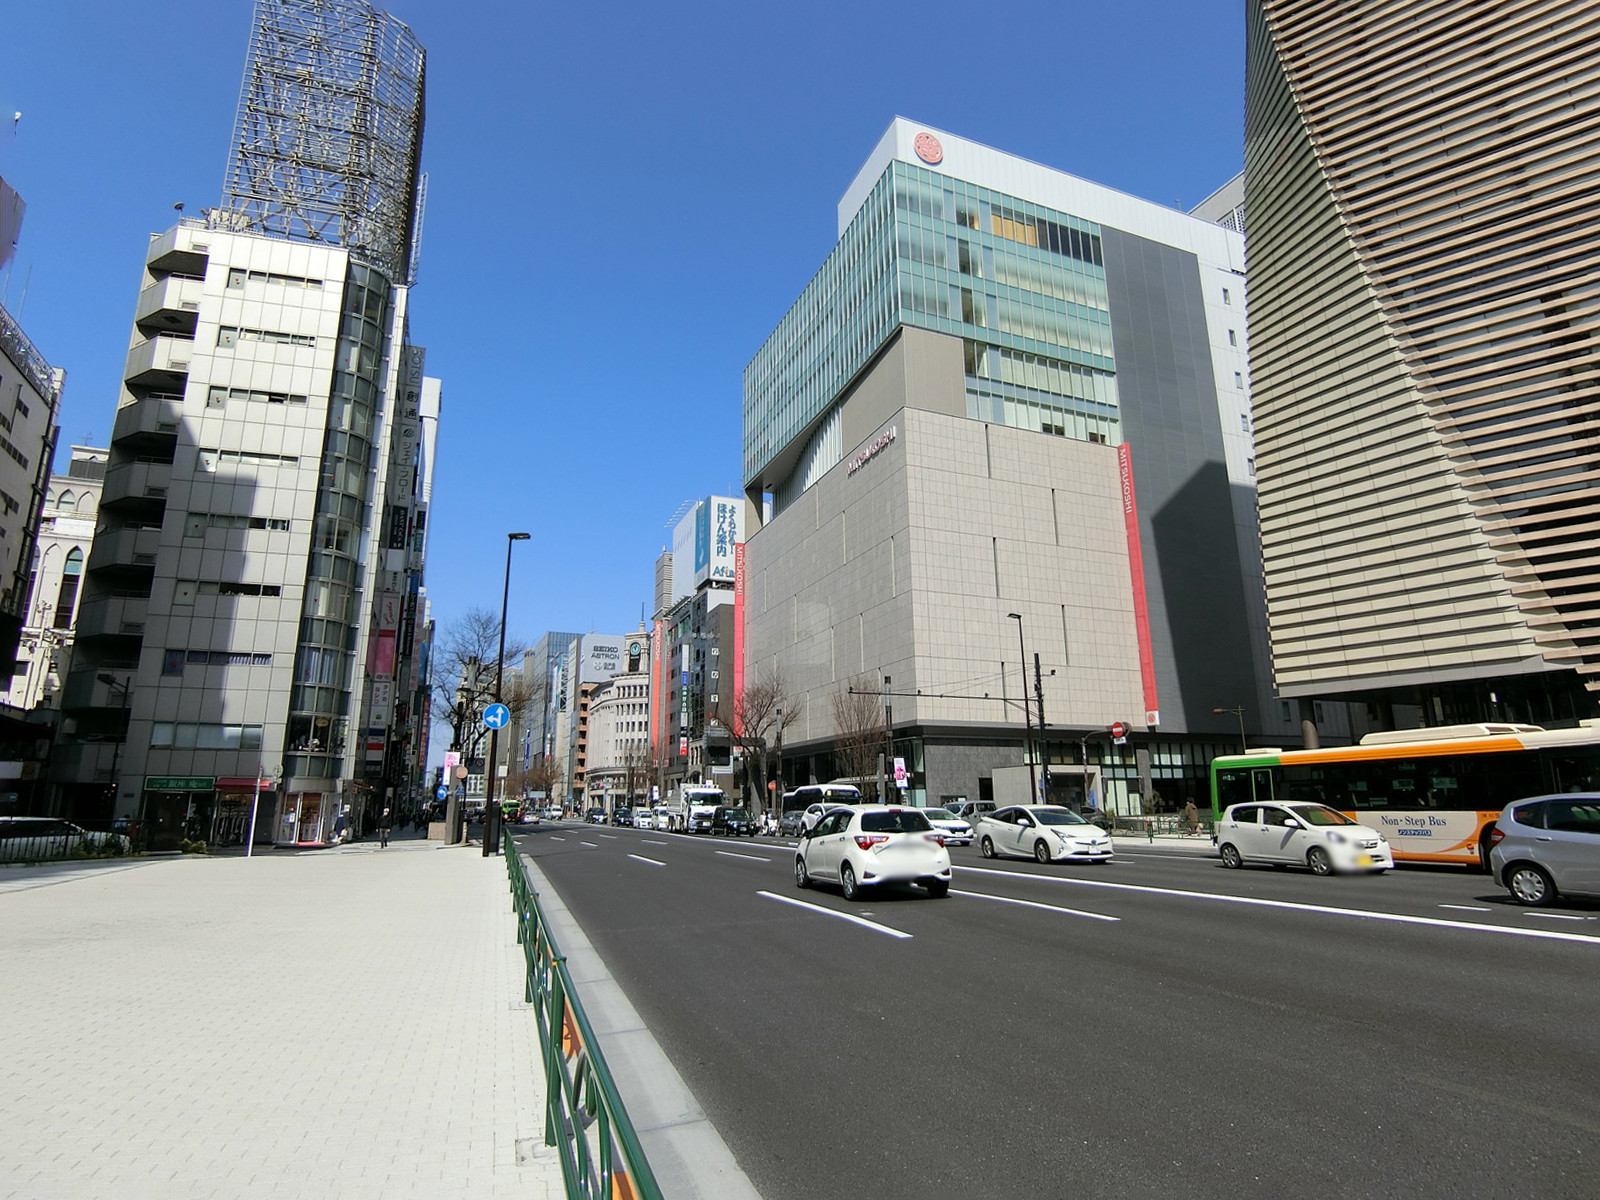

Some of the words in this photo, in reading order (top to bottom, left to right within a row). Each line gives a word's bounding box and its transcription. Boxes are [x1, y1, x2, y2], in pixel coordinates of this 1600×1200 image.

[409, 348, 423, 384] SOTSU
[404, 390, 419, 420] 創通
[847, 426, 896, 475] MITSUKOSHI
[1120, 448, 1133, 513] MITSUKOSHI
[716, 503, 728, 557] ほけん案内
[736, 546, 744, 595] MITSUKOSHI
[590, 652, 620, 660] ASTRON
[593, 645, 619, 653] SEIKO
[1428, 815, 1447, 827] Bus
